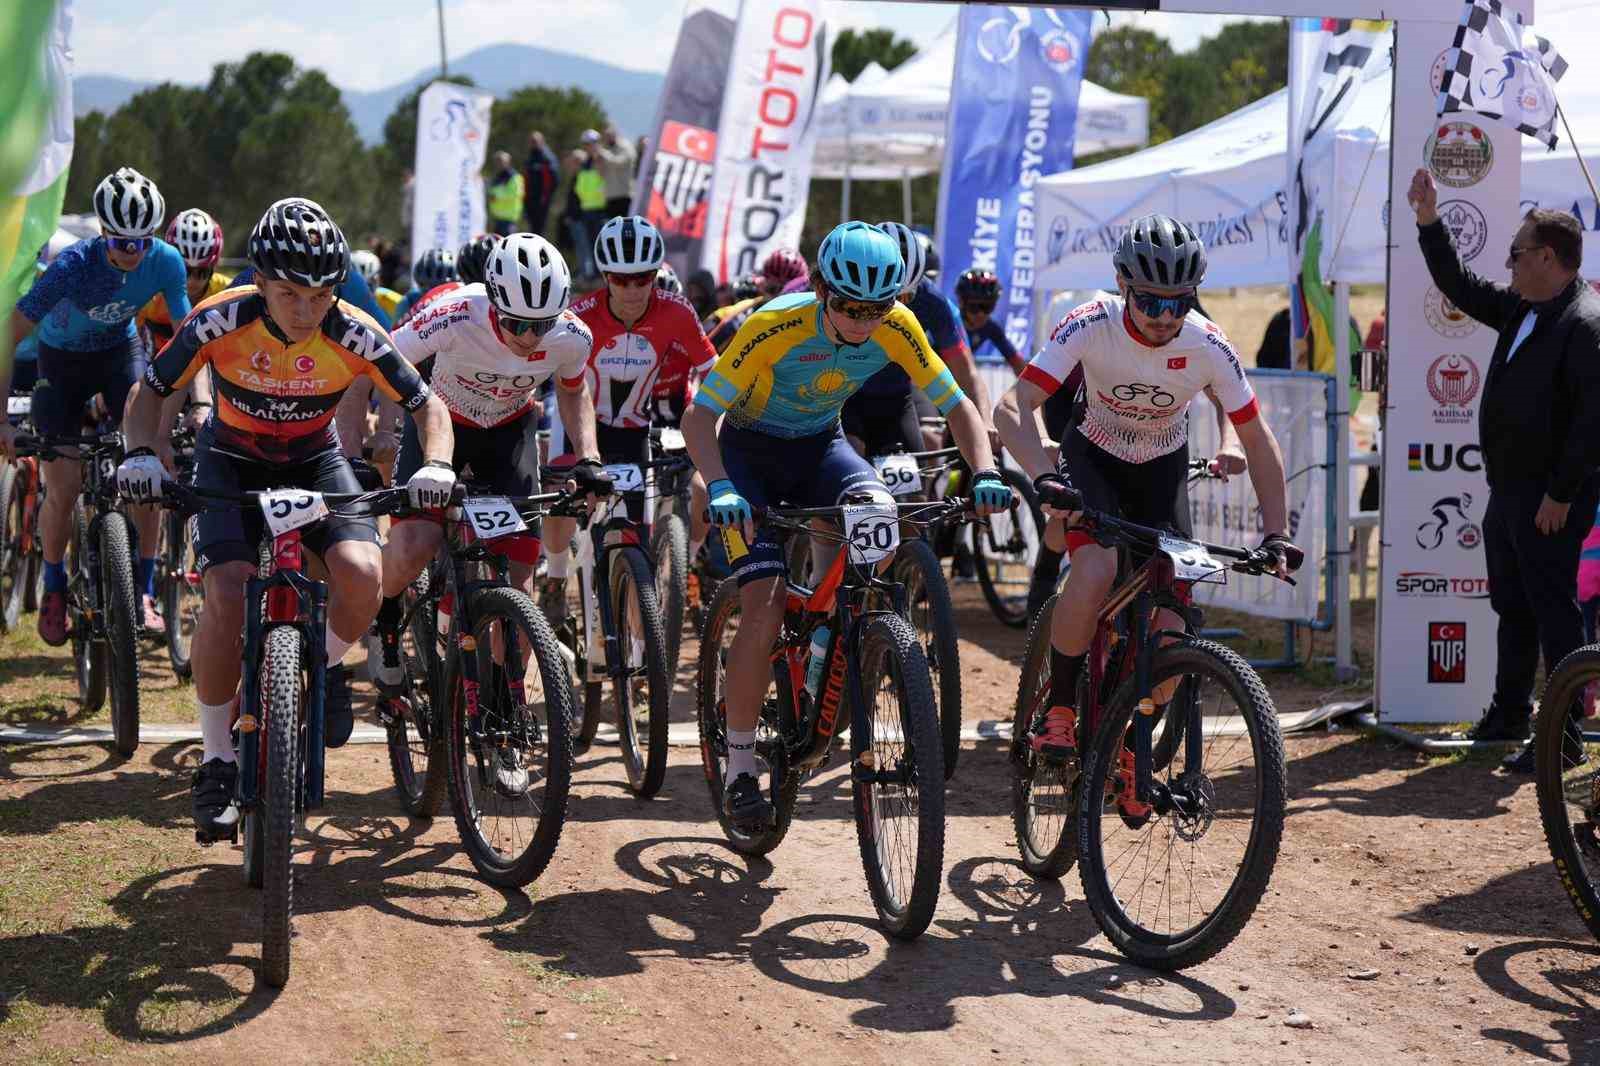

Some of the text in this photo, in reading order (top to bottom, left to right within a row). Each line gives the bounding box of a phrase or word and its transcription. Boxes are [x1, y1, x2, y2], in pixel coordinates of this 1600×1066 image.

[968, 197, 1000, 270] KİYE
[194, 301, 240, 343] HV
[418, 319, 449, 340] Cycling
[1056, 318, 1087, 345] Cycling
[339, 325, 392, 363] HV
[732, 317, 803, 370] QAZAQSTAN
[882, 318, 929, 369] AZAQSTAN
[1206, 333, 1236, 362] Cycling
[1425, 443, 1483, 472] UC
[882, 466, 914, 486] 56
[473, 510, 516, 531] 52
[852, 521, 893, 551] 50
[1395, 578, 1489, 593] SPORTOT
